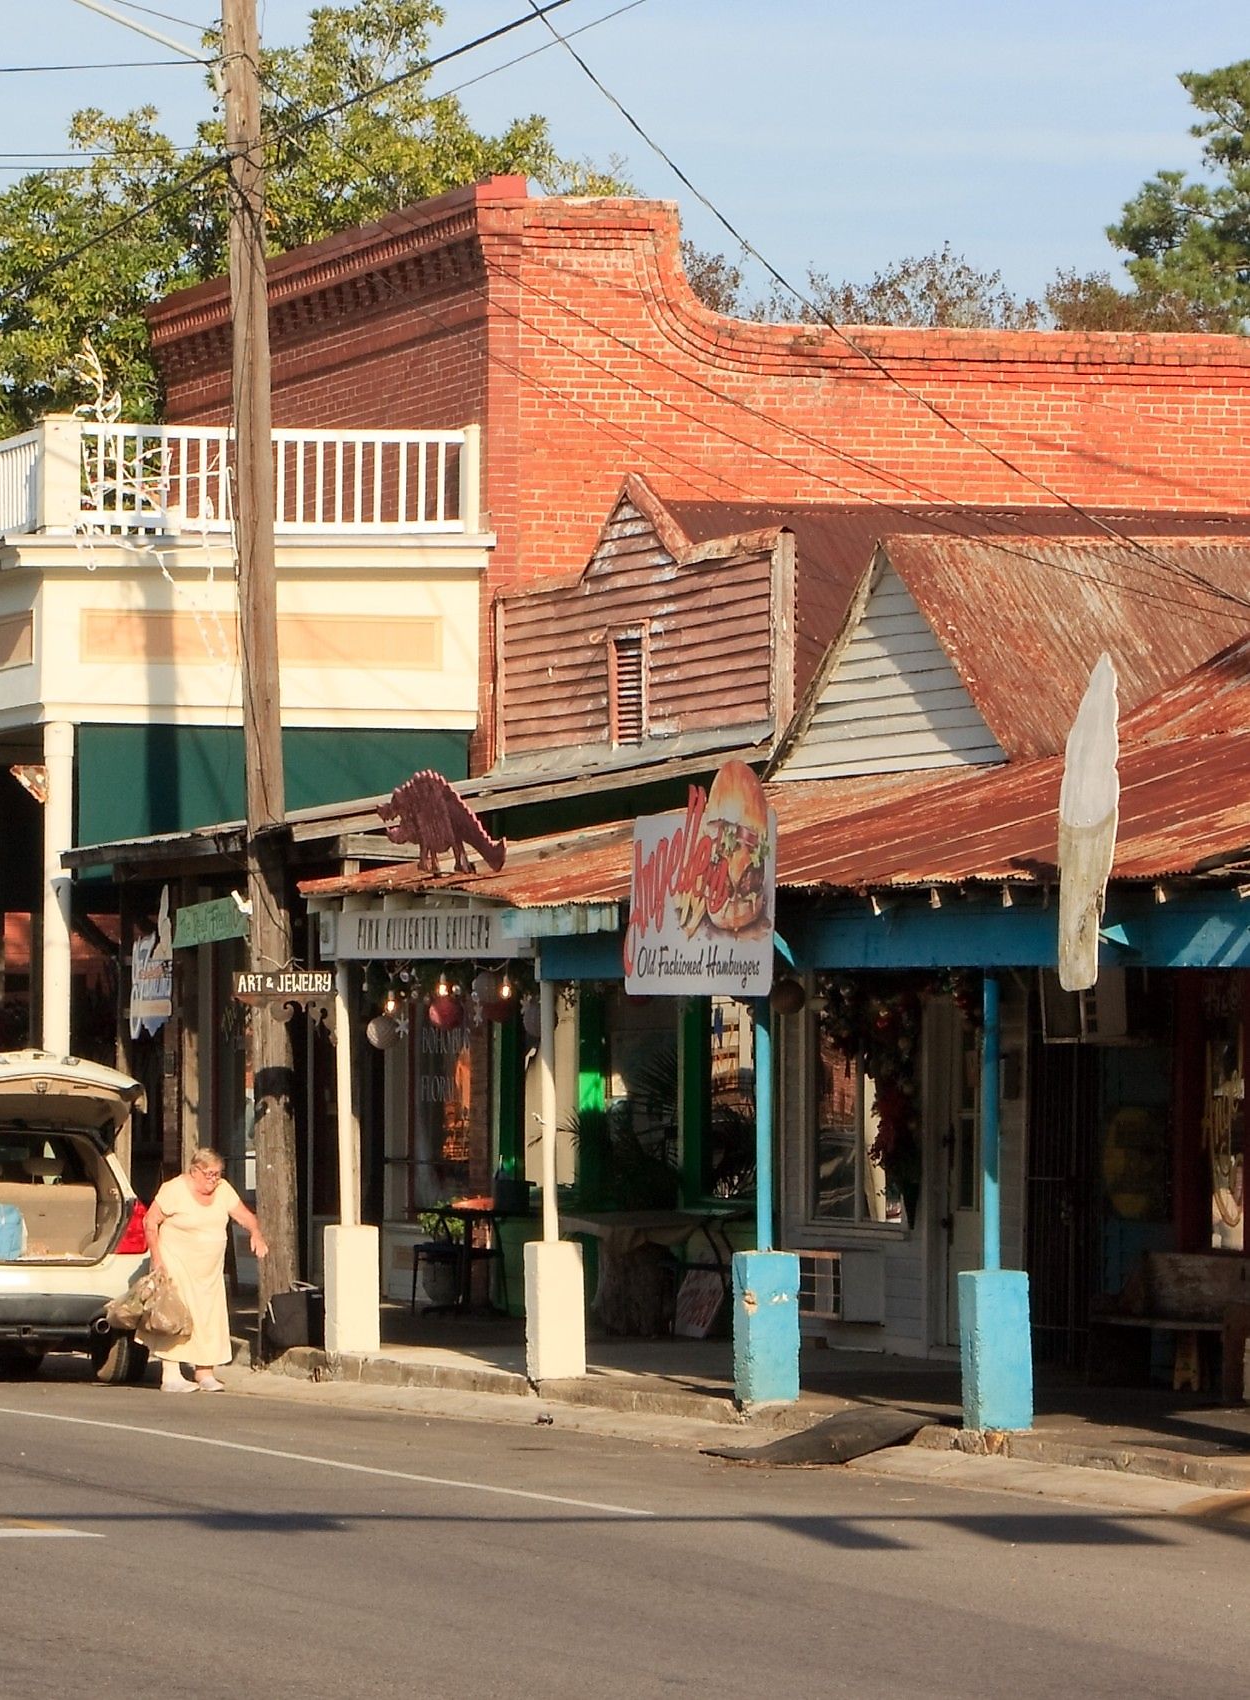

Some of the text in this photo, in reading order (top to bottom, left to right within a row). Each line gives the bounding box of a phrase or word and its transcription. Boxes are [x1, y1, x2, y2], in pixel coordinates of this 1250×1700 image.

[357, 914, 491, 951] PINK ALLIGATOR GALLERY
[237, 973, 332, 993] ART & JEWELRY
[636, 944, 761, 988] Old Fashioned Hamburgers
